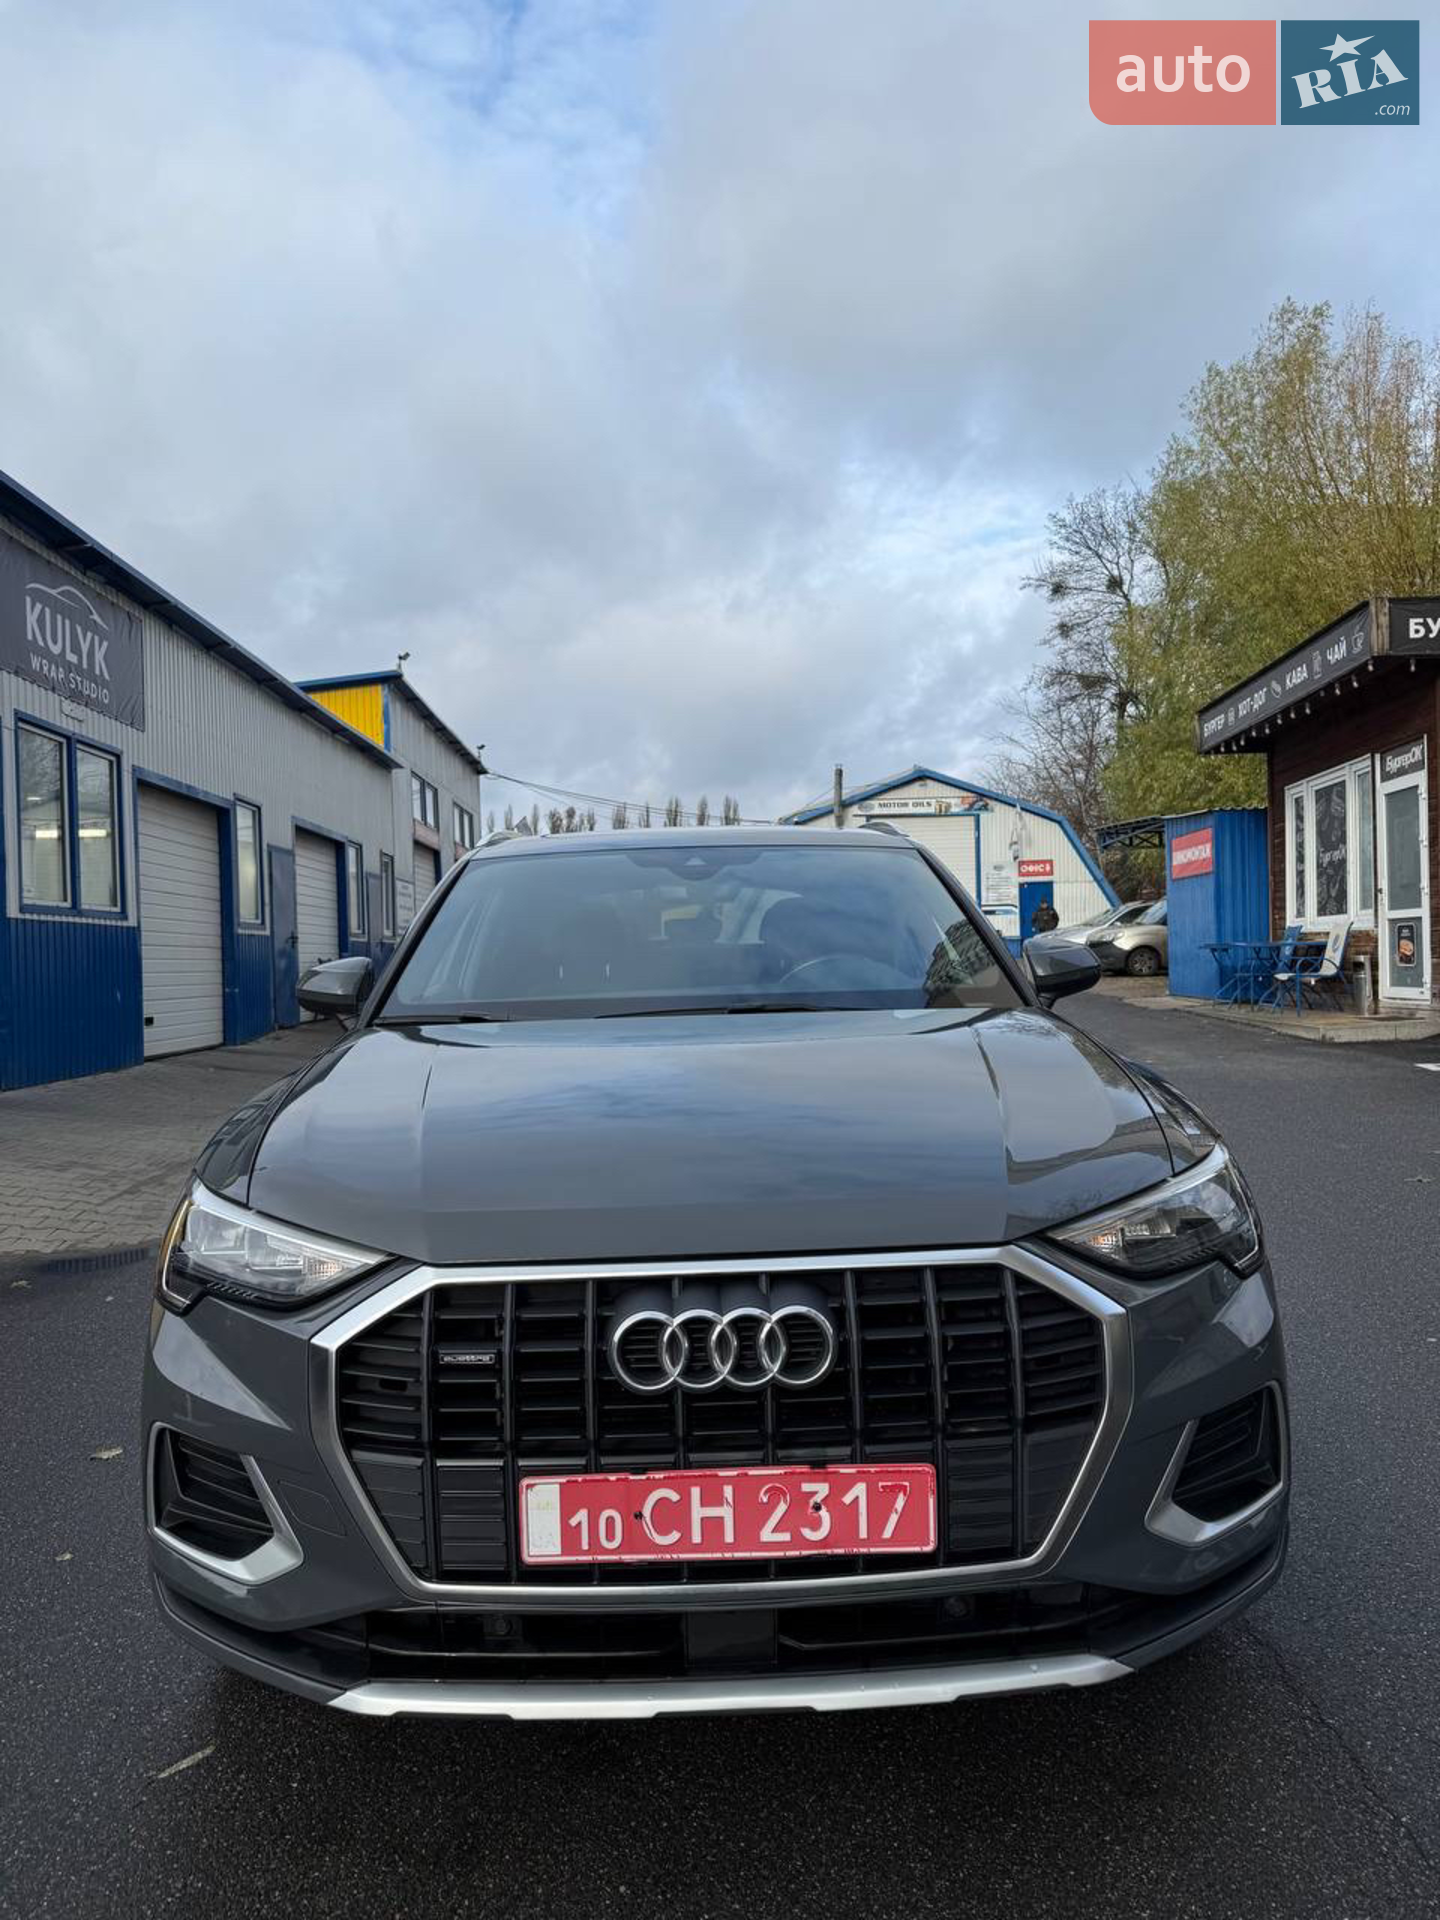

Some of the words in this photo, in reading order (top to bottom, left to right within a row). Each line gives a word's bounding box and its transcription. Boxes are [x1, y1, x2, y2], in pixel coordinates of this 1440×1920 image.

[25, 595, 110, 681] KULYK
[30, 651, 66, 685] WRAP
[69, 671, 109, 704] STUDIO
[1203, 713, 1225, 738] БУРГЕР
[1238, 687, 1267, 719] ХОТ-ДОГ
[1285, 662, 1309, 691] КАВА
[1326, 635, 1347, 665] ЧАЙ
[878, 801, 909, 809] MOTOR
[912, 800, 932, 808] OILS
[568, 1508, 623, 1551] 10
[641, 1484, 735, 1546] CH
[759, 1481, 910, 1543] 2317
